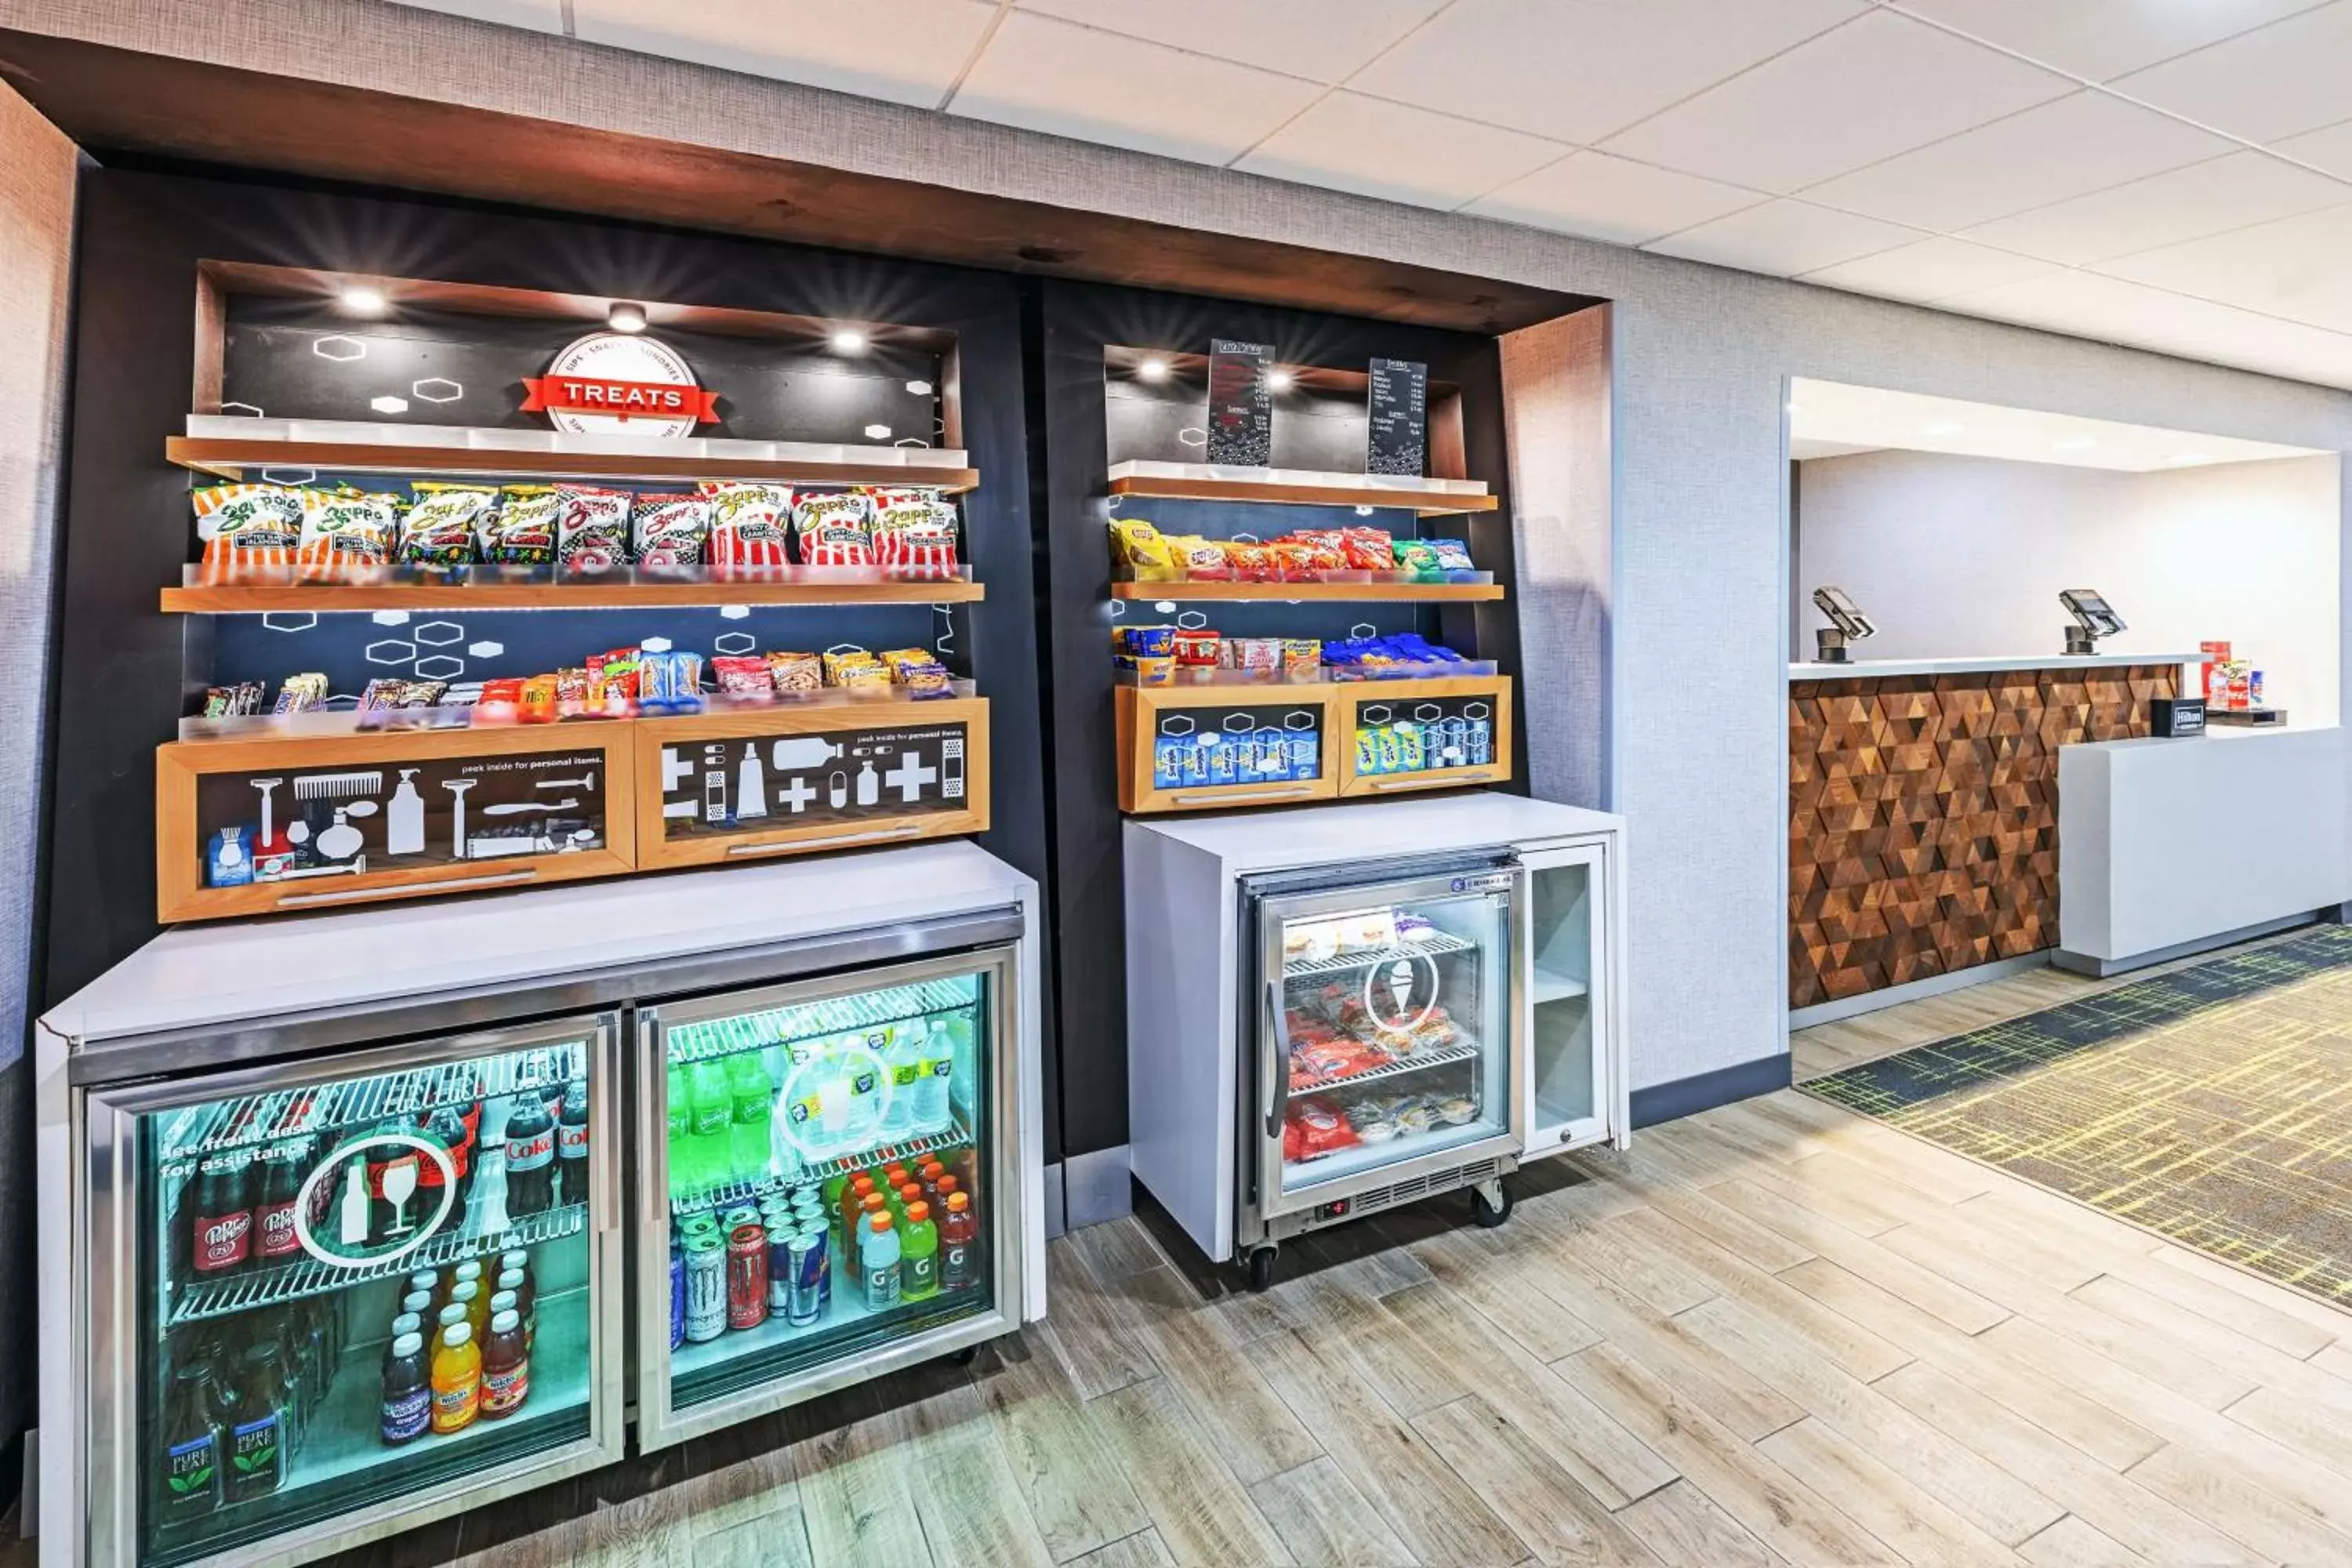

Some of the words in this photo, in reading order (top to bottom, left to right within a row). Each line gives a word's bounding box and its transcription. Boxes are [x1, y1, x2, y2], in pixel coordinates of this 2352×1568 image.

[564, 382, 682, 407] TREATS
[2177, 711, 2201, 724] Hilton
[909, 730, 940, 740] personal
[462, 764, 484, 775] peek
[486, 763, 514, 771] inside
[530, 757, 572, 770] personal
[205, 1135, 262, 1152] front
[507, 1136, 552, 1159] Coke
[160, 1164, 196, 1178] for
[200, 1143, 315, 1171] assistance.
[949, 1249, 964, 1265] G
[916, 1258, 929, 1275] G
[872, 1269, 885, 1286] G
[238, 1427, 273, 1445] PURE
[238, 1437, 272, 1454] LEAF
[173, 1448, 210, 1465] PURE
[173, 1457, 209, 1475] LEAF
